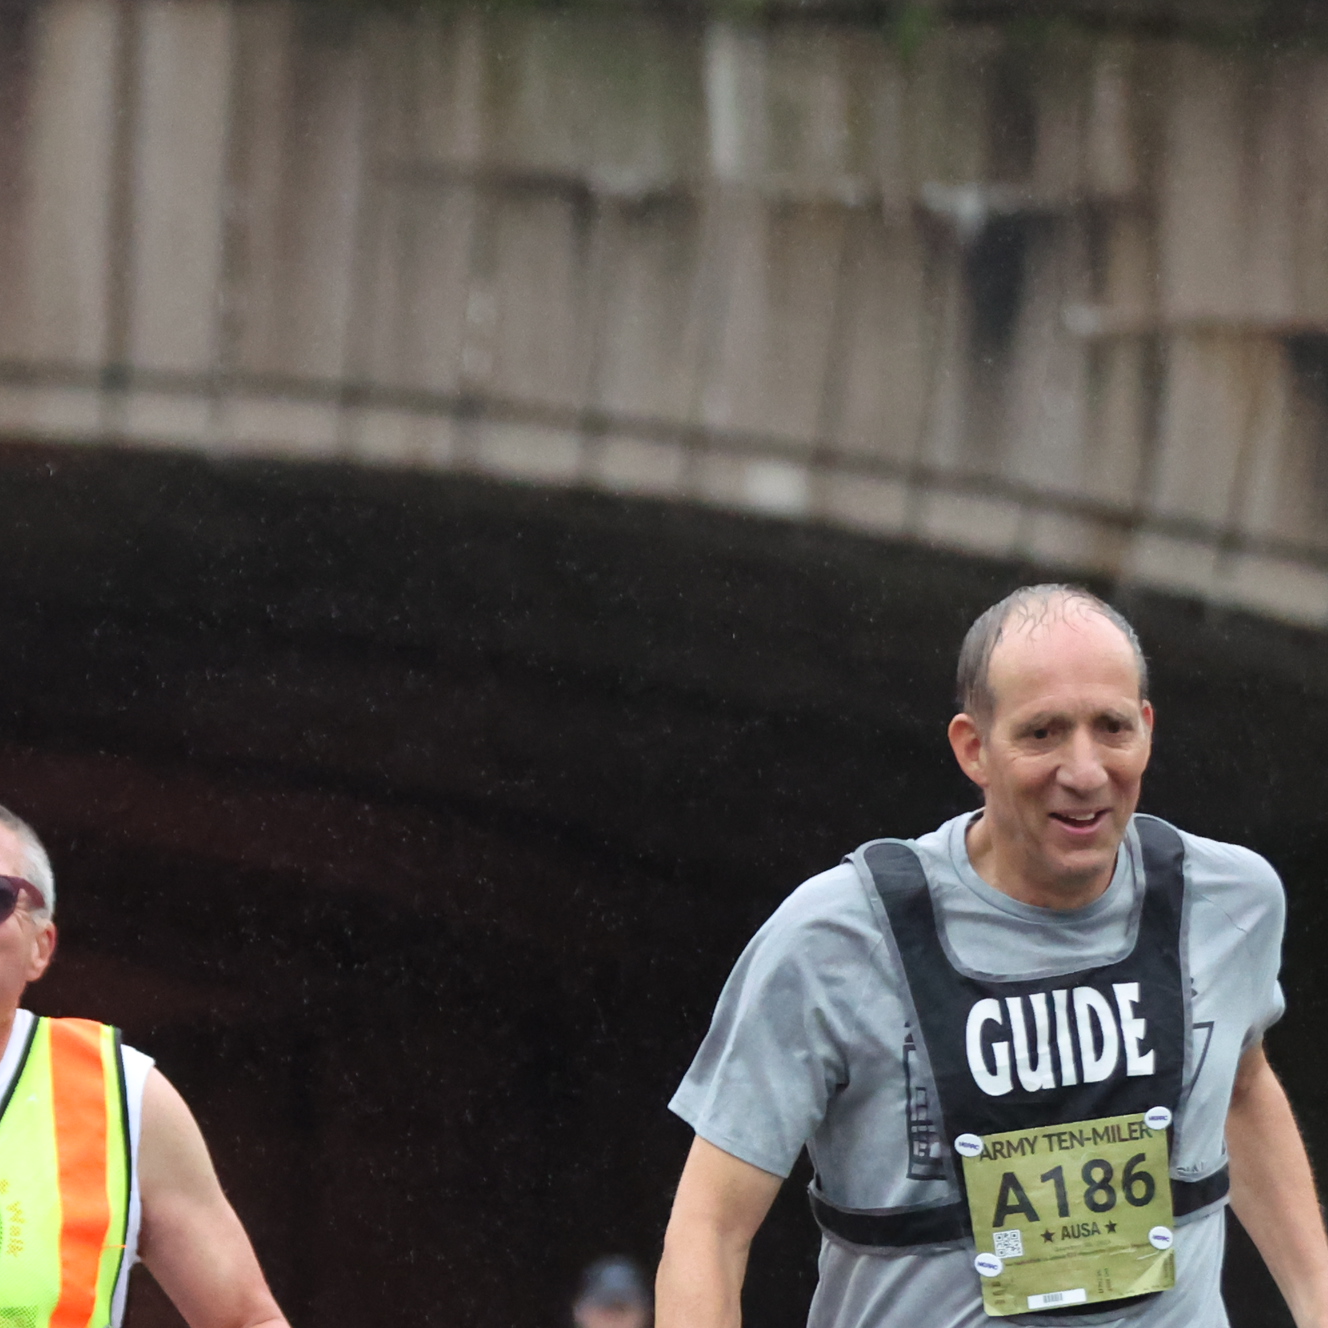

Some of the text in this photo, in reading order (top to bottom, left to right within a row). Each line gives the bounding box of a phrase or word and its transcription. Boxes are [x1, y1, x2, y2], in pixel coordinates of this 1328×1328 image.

[966, 982, 1155, 1096] GUIDE
[979, 1121, 1153, 1161] ARMY TEN-MILER
[992, 1152, 1155, 1228] A186
[1061, 1221, 1100, 1240] AUSA
